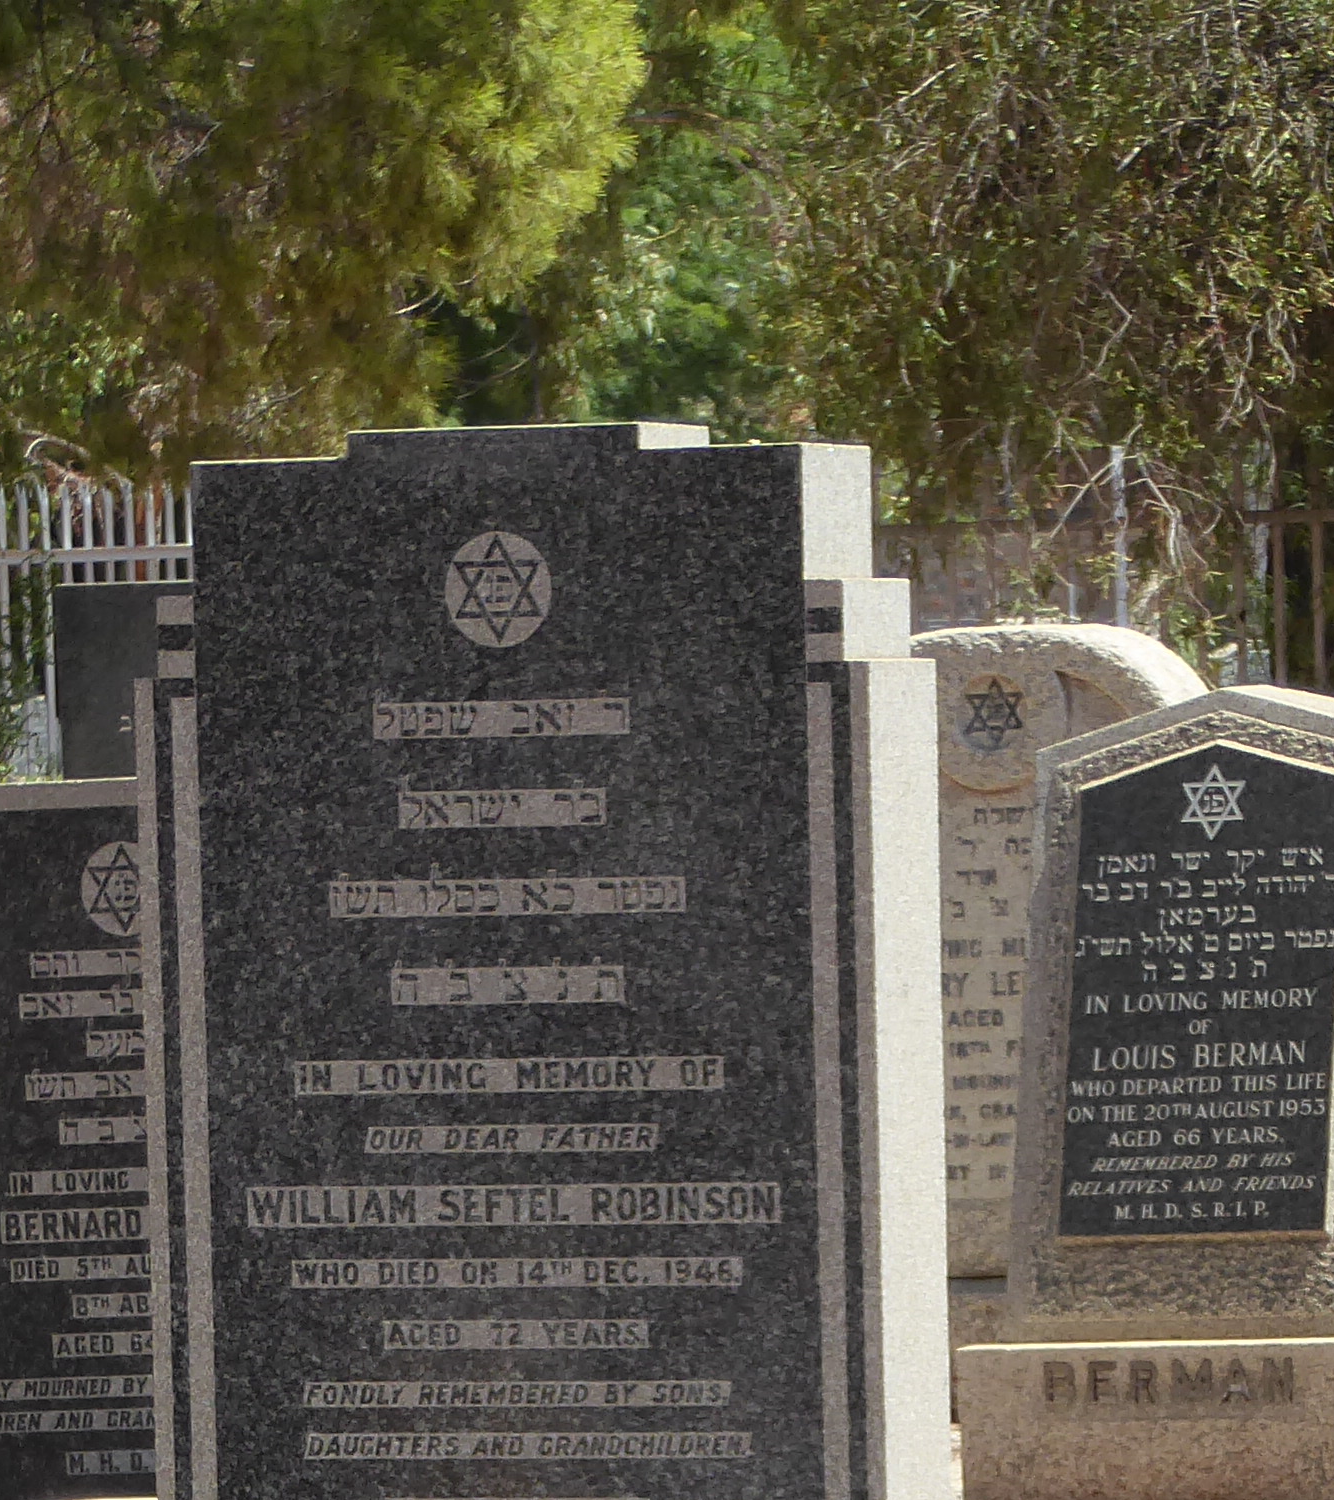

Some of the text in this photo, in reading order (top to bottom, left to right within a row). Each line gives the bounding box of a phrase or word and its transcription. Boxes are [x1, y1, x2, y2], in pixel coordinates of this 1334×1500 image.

[1085, 987, 1318, 1015] IN LOVING MEMORY
[1188, 1019, 1212, 1035] OF
[1092, 1040, 1306, 1072] LOUIS BERMAN
[299, 1059, 720, 1092] IN LOVING MEMORY OF
[1071, 1073, 1326, 1097] WHO DEPARTED THIS LIFE
[1067, 1106, 1094, 1123] ON
[1102, 1105, 1138, 1122] THE
[1194, 1101, 1274, 1119] AUGUST
[1279, 1099, 1326, 1117] 1953
[370, 1127, 519, 1151] OUR DEAR
[1107, 1130, 1161, 1148] AGED
[1173, 1128, 1200, 1146] 66
[1091, 1152, 1295, 1172] REMEMBERED BY HIS
[9, 1170, 129, 1194] IN LOVING
[1067, 1175, 1316, 1196] RELATIVES AND FRIENDS
[252, 1186, 778, 1224] WILLIAM SEFTEL ROBINSON
[5, 1209, 142, 1241] BERNARD
[14, 1260, 59, 1281] DIED
[295, 1262, 359, 1286] WHO
[379, 1262, 439, 1285] DIED
[462, 1261, 497, 1284] ON
[56, 1334, 114, 1356] AGED
[388, 1323, 521, 1347] AGED 72
[24, 1379, 112, 1398] MOURNED
[123, 1377, 148, 1395] BY
[1043, 1357, 1294, 1404] BERMAN
[306, 1383, 636, 1406] FONDLY REMEMBERED BY
[55, 1411, 94, 1430] AND
[308, 1435, 524, 1458] DAUGHTERS AND
